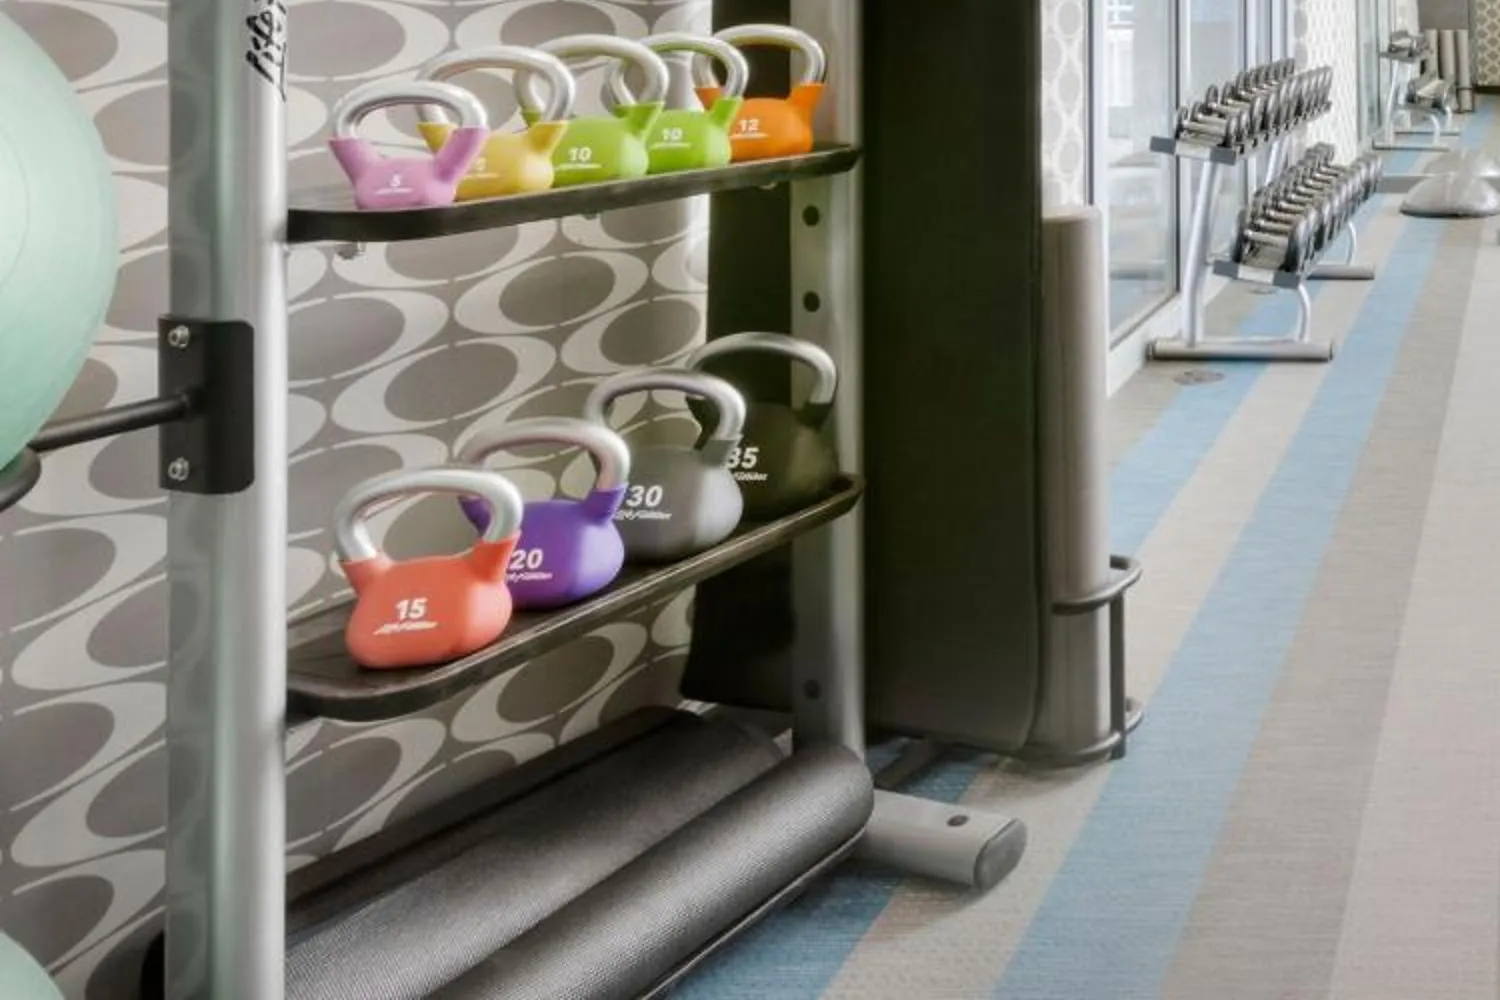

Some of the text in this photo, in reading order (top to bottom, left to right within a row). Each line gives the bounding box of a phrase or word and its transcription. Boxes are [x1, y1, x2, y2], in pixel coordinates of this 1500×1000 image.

[661, 127, 683, 141] 10
[738, 118, 760, 132] 12
[568, 147, 592, 162] 10
[725, 447, 760, 469] 35
[625, 484, 664, 507] 30
[509, 548, 543, 570] 20
[395, 597, 428, 620] 15
